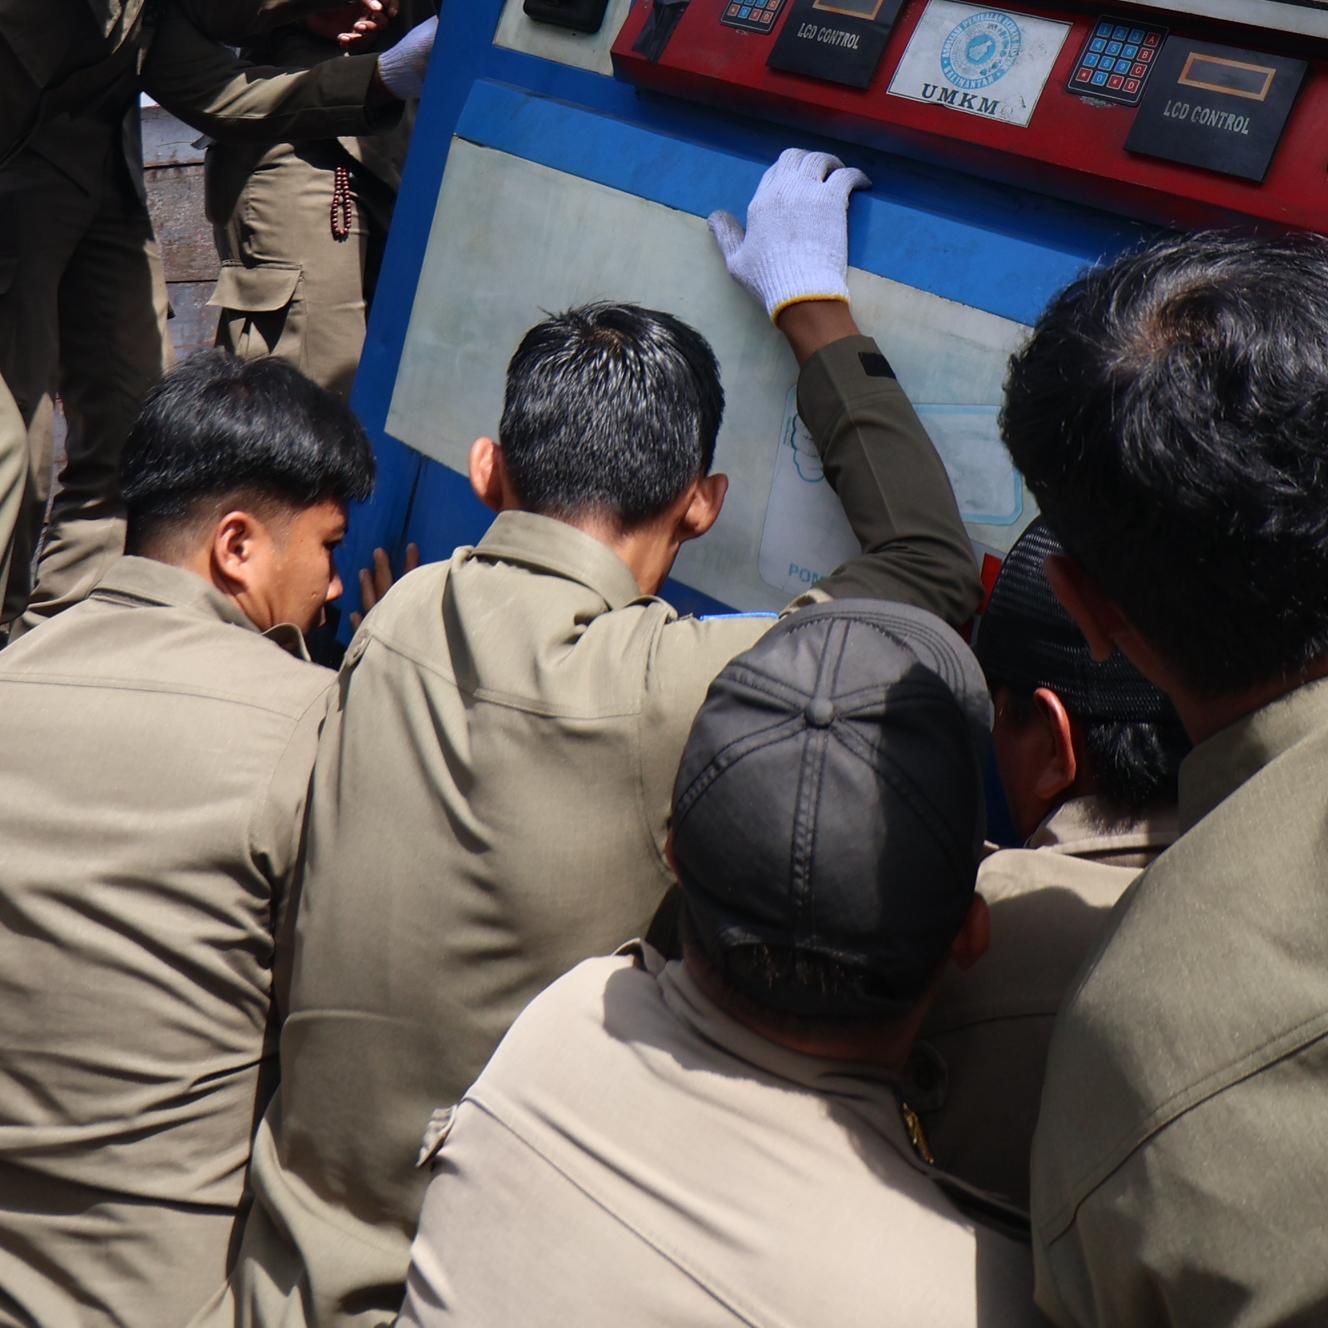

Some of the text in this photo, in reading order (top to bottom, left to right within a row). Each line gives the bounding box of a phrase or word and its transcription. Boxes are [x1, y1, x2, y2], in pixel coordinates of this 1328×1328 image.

[797, 22, 861, 51] LCD CONTROL
[922, 82, 1000, 116] UMKM
[1163, 99, 1251, 136] LCD CONTROL
